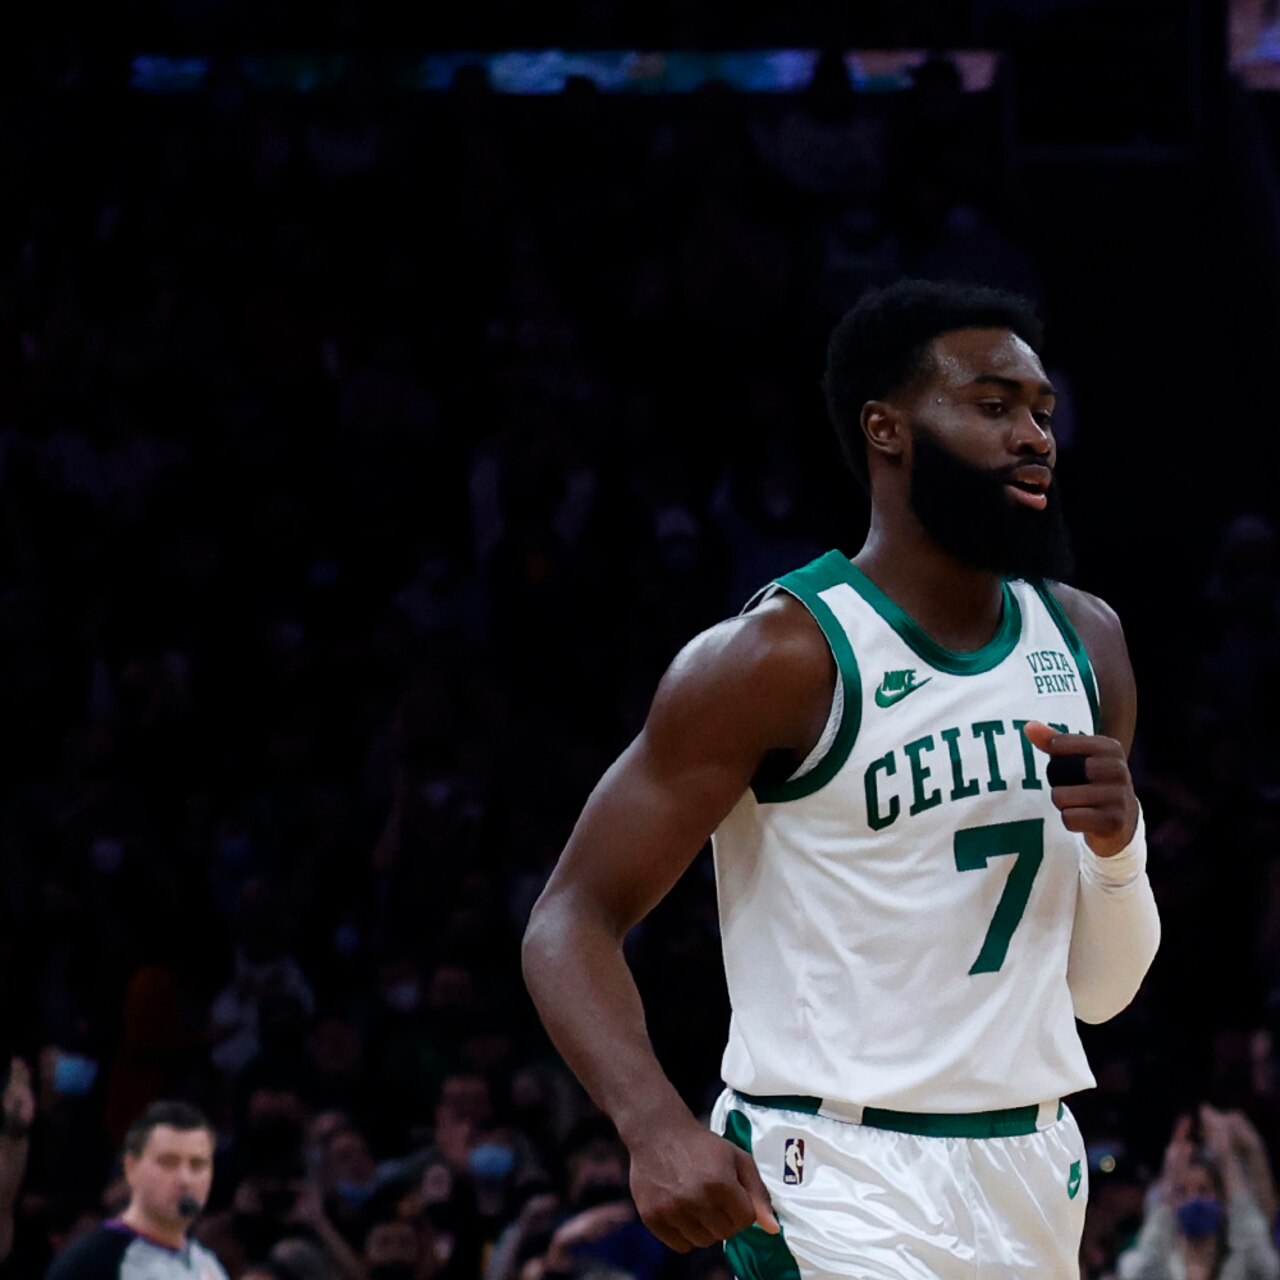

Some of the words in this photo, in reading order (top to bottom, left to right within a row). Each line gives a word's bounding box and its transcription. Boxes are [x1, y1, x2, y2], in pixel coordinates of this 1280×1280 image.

[1026, 650, 1073, 673] VISTA
[1034, 674, 1077, 694] PRINT
[864, 720, 1086, 831] CELTI
[953, 818, 1045, 976] 7
